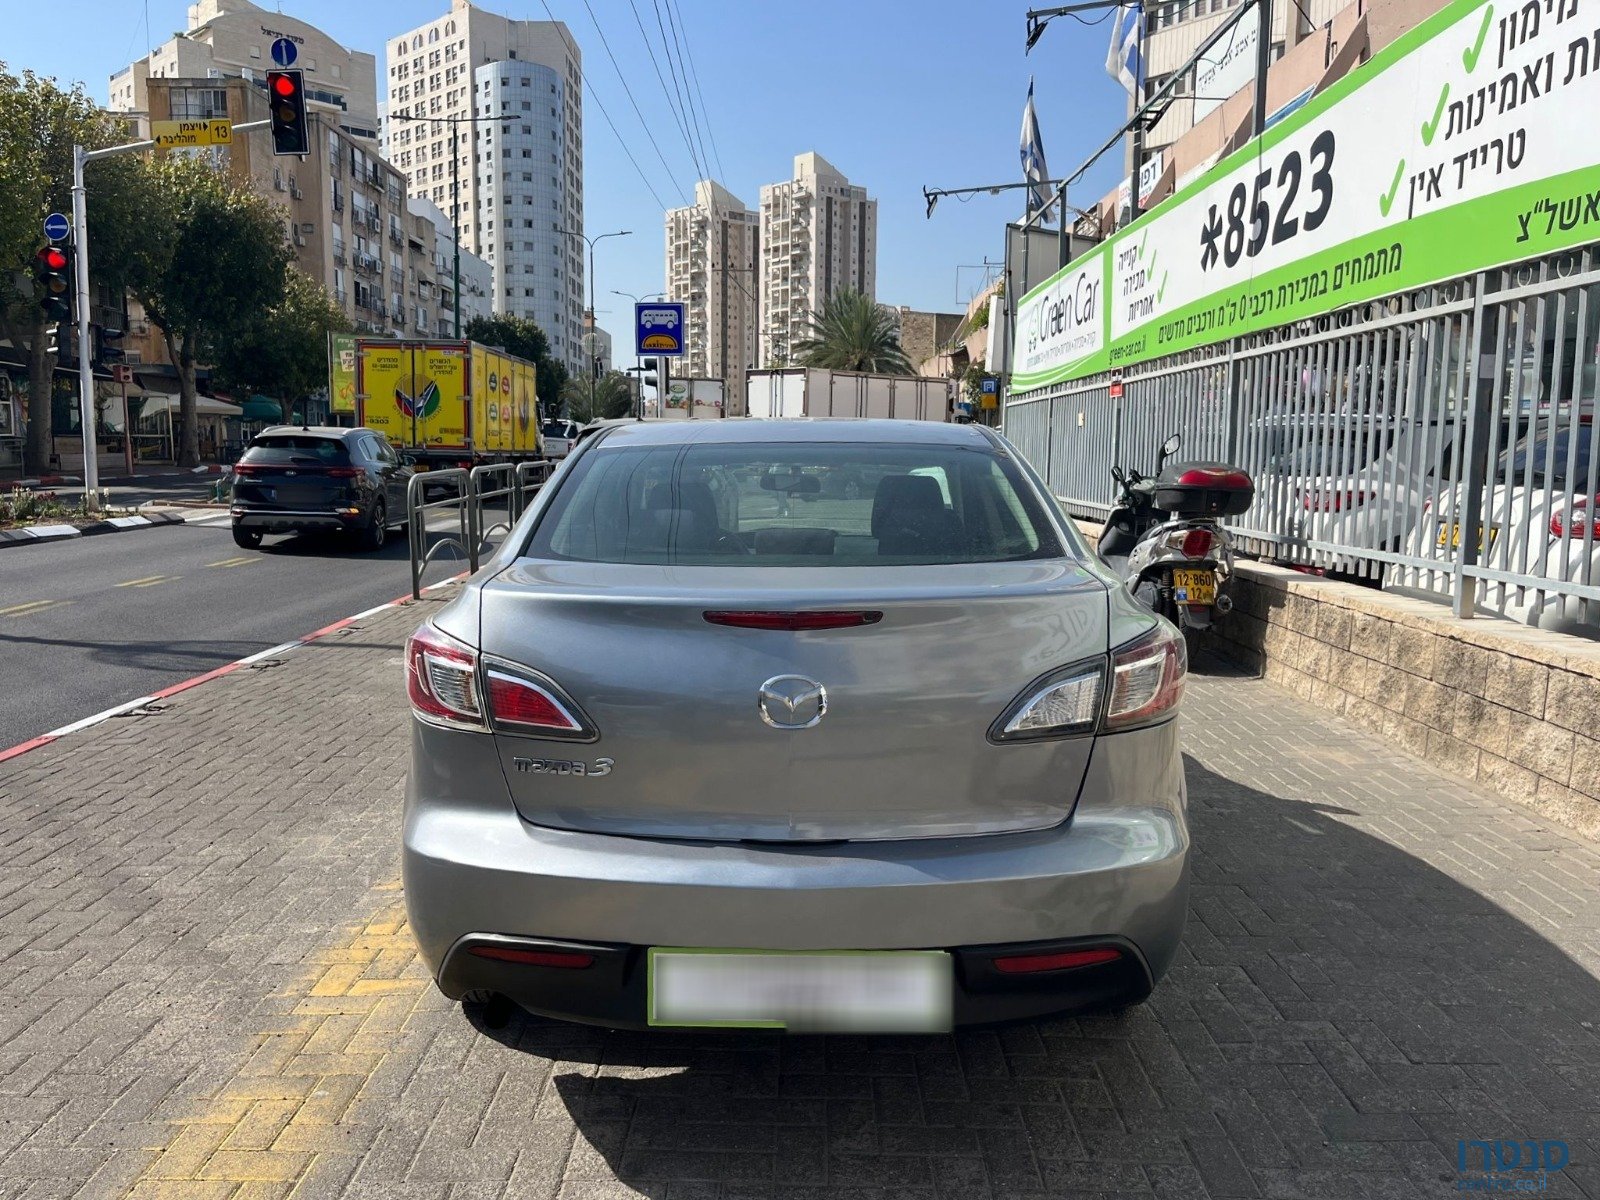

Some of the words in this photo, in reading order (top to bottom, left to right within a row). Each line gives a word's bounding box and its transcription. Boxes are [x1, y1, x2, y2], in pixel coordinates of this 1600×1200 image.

[1445, 52, 1554, 141] ואמינות
[214, 126, 228, 138] 13
[1453, 128, 1526, 191] טרייד
[1407, 162, 1444, 220] אין
[1118, 245, 1137, 271] קנייה
[1332, 242, 1402, 291] מתמחים
[1123, 269, 1145, 296] מכירה
[1276, 269, 1328, 310] במכירת
[1040, 295, 1073, 342] Green
[1075, 272, 1099, 326] Car
[1128, 294, 1154, 322] אחריות
[1249, 289, 1274, 317] רכבי
[1158, 320, 1184, 344] חדשים
[1187, 309, 1215, 335] ורכבים
[586, 757, 615, 777] 3
